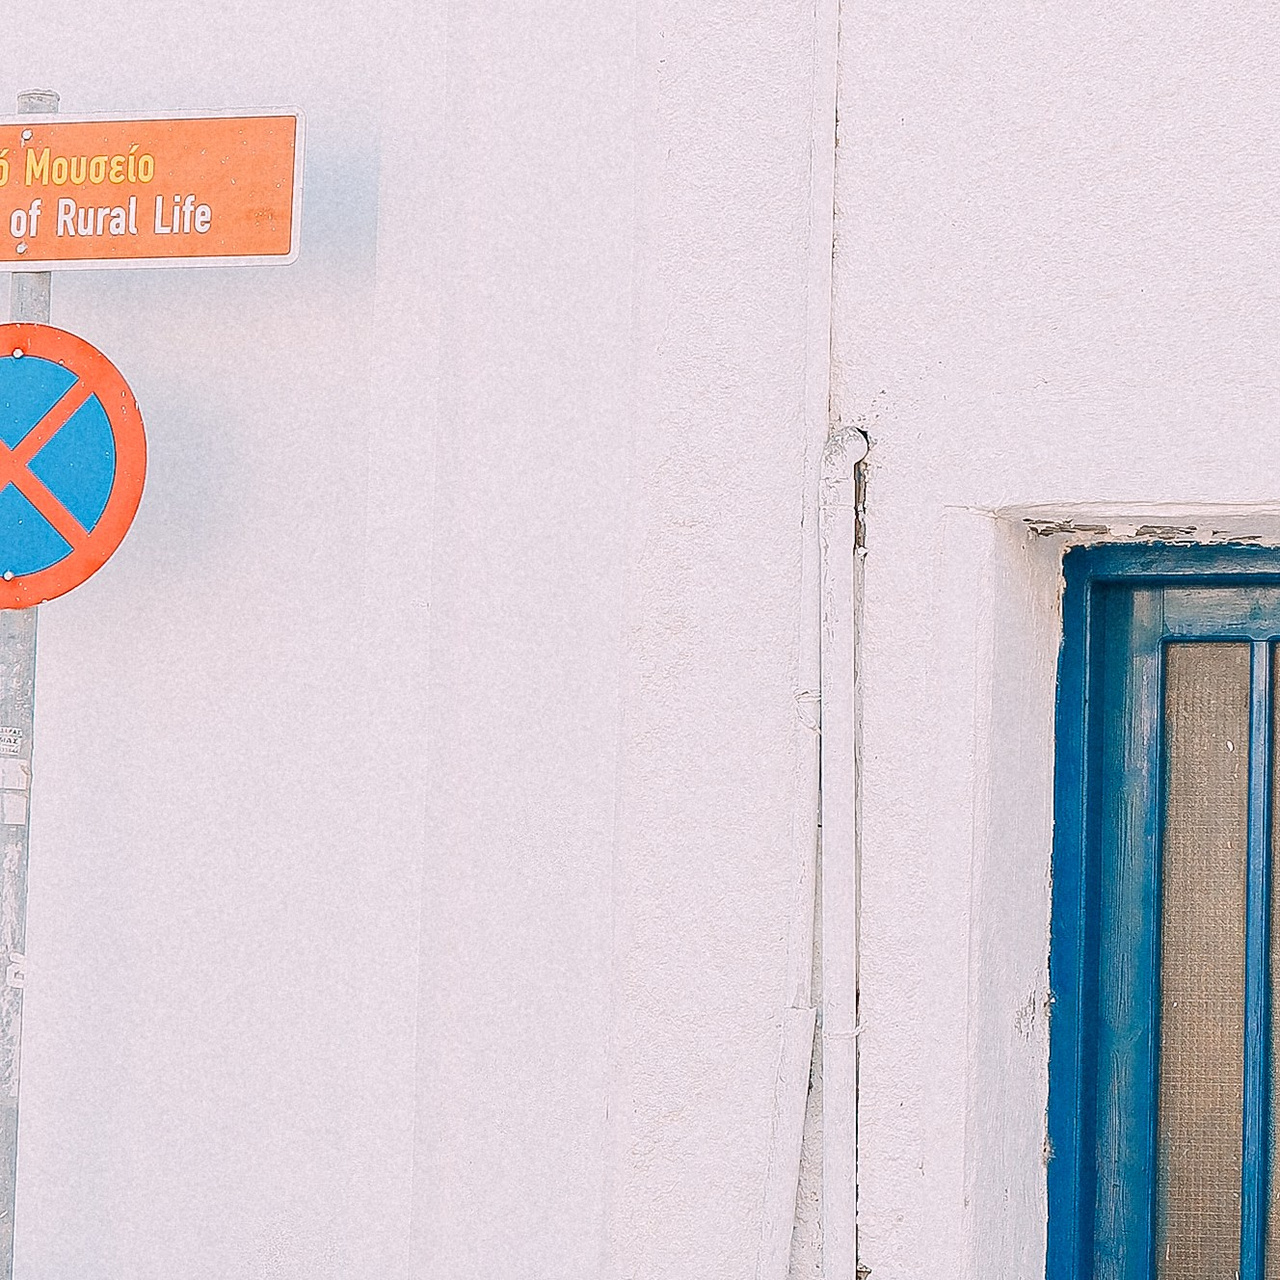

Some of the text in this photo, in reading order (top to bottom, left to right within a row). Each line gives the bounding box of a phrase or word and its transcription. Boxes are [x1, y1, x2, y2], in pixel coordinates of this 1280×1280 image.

[25, 144, 154, 186] Μουσείο
[10, 194, 212, 238] of Rural Life
